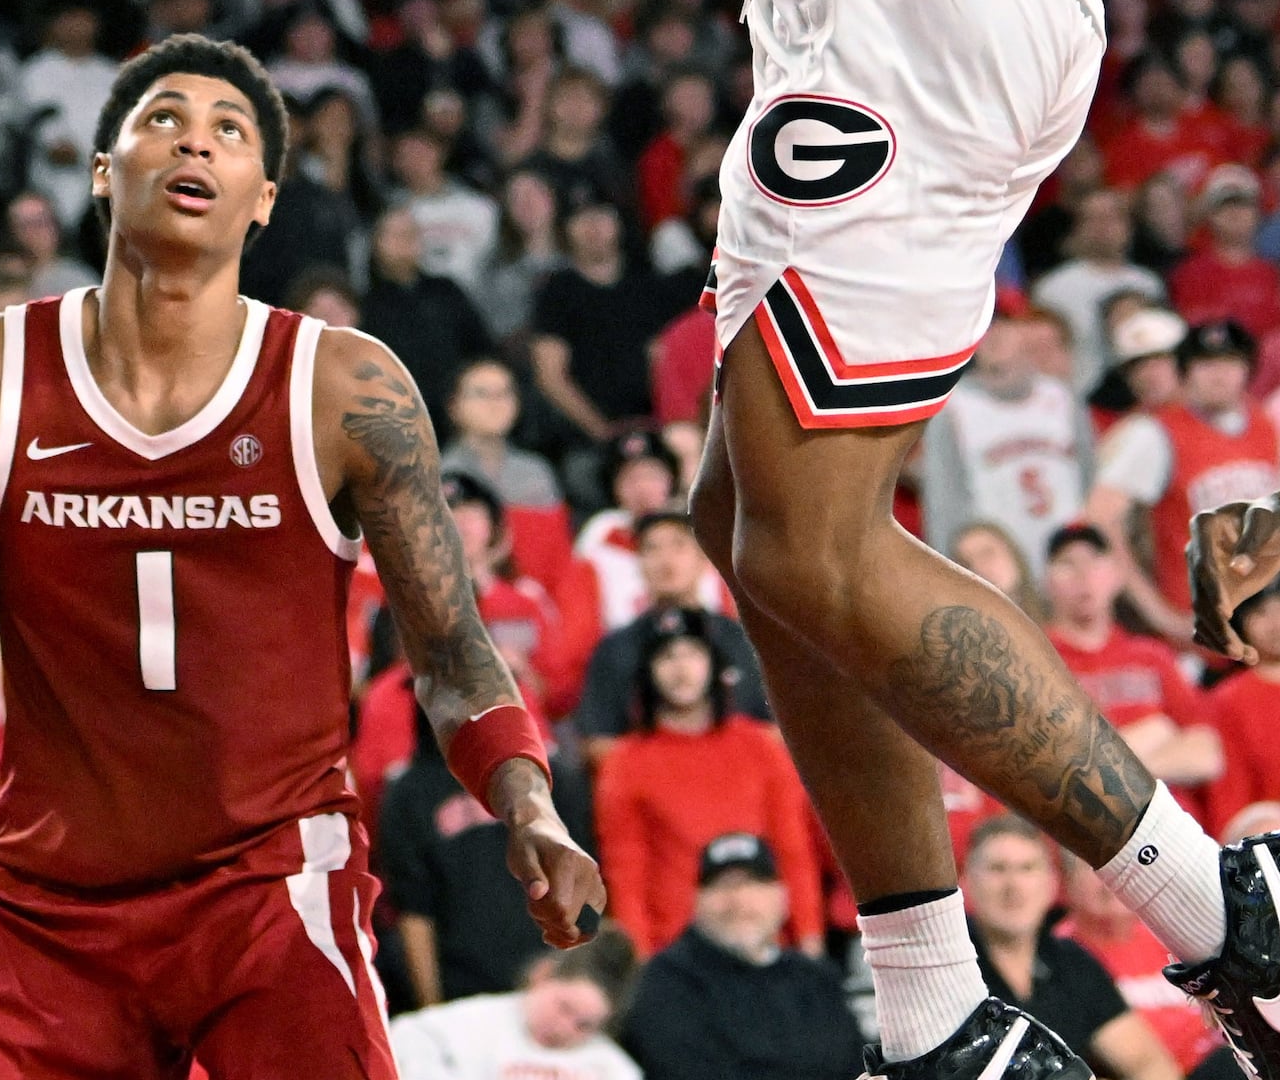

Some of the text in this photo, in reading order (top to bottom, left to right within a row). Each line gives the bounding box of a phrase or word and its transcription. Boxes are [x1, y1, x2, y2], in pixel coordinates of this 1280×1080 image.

[751, 100, 890, 200] G
[231, 436, 261, 467] SEC
[20, 489, 282, 530] ARKANSAS
[135, 550, 177, 692] 1
